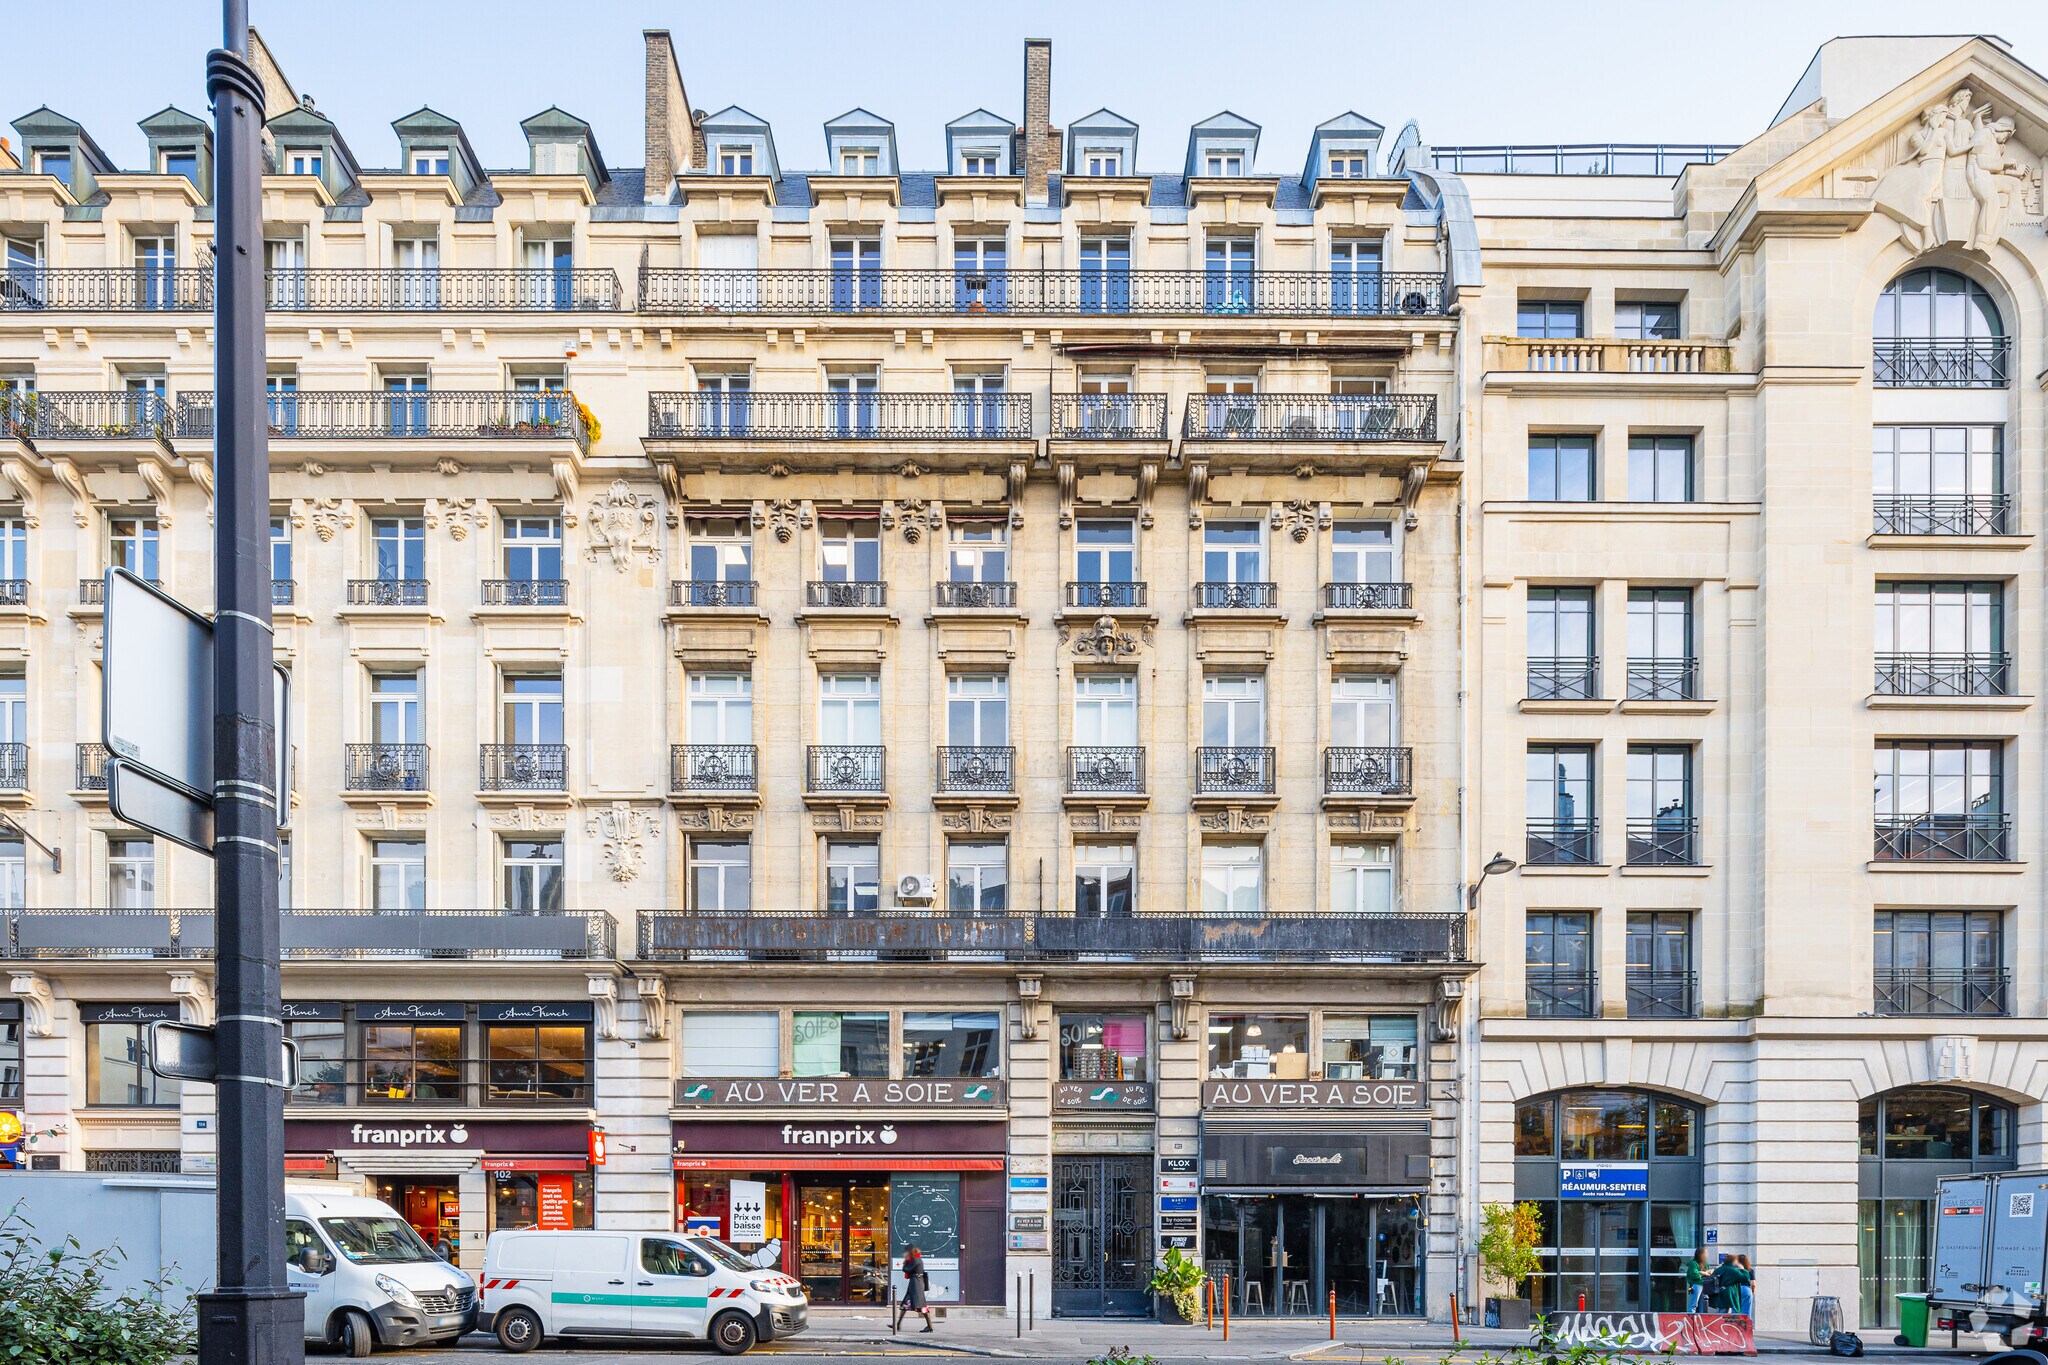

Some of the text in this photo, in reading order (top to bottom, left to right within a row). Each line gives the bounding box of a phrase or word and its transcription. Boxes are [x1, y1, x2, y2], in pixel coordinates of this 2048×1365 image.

[98, 1008, 133, 1020] Anne
[374, 1006, 410, 1020] Anne
[498, 1006, 534, 1020] Anne
[795, 1012, 839, 1043] SOIES
[725, 1082, 954, 1102] AU VER A SOIE
[1059, 1085, 1083, 1094] AU VER
[1125, 1085, 1145, 1094] AU FIL
[1212, 1084, 1417, 1105] AU VER A SOIE
[1067, 1096, 1082, 1105] SOIE
[1122, 1096, 1147, 1105] DE SOIE
[351, 1124, 447, 1147] franprix
[782, 1124, 876, 1148] franprix
[493, 1170, 512, 1179] 102
[1563, 1170, 1571, 1180] P
[1561, 1182, 1647, 1191] RÉAUMUR-SENTIER
[733, 1213, 749, 1221] Prix
[733, 1221, 761, 1230] baisse
